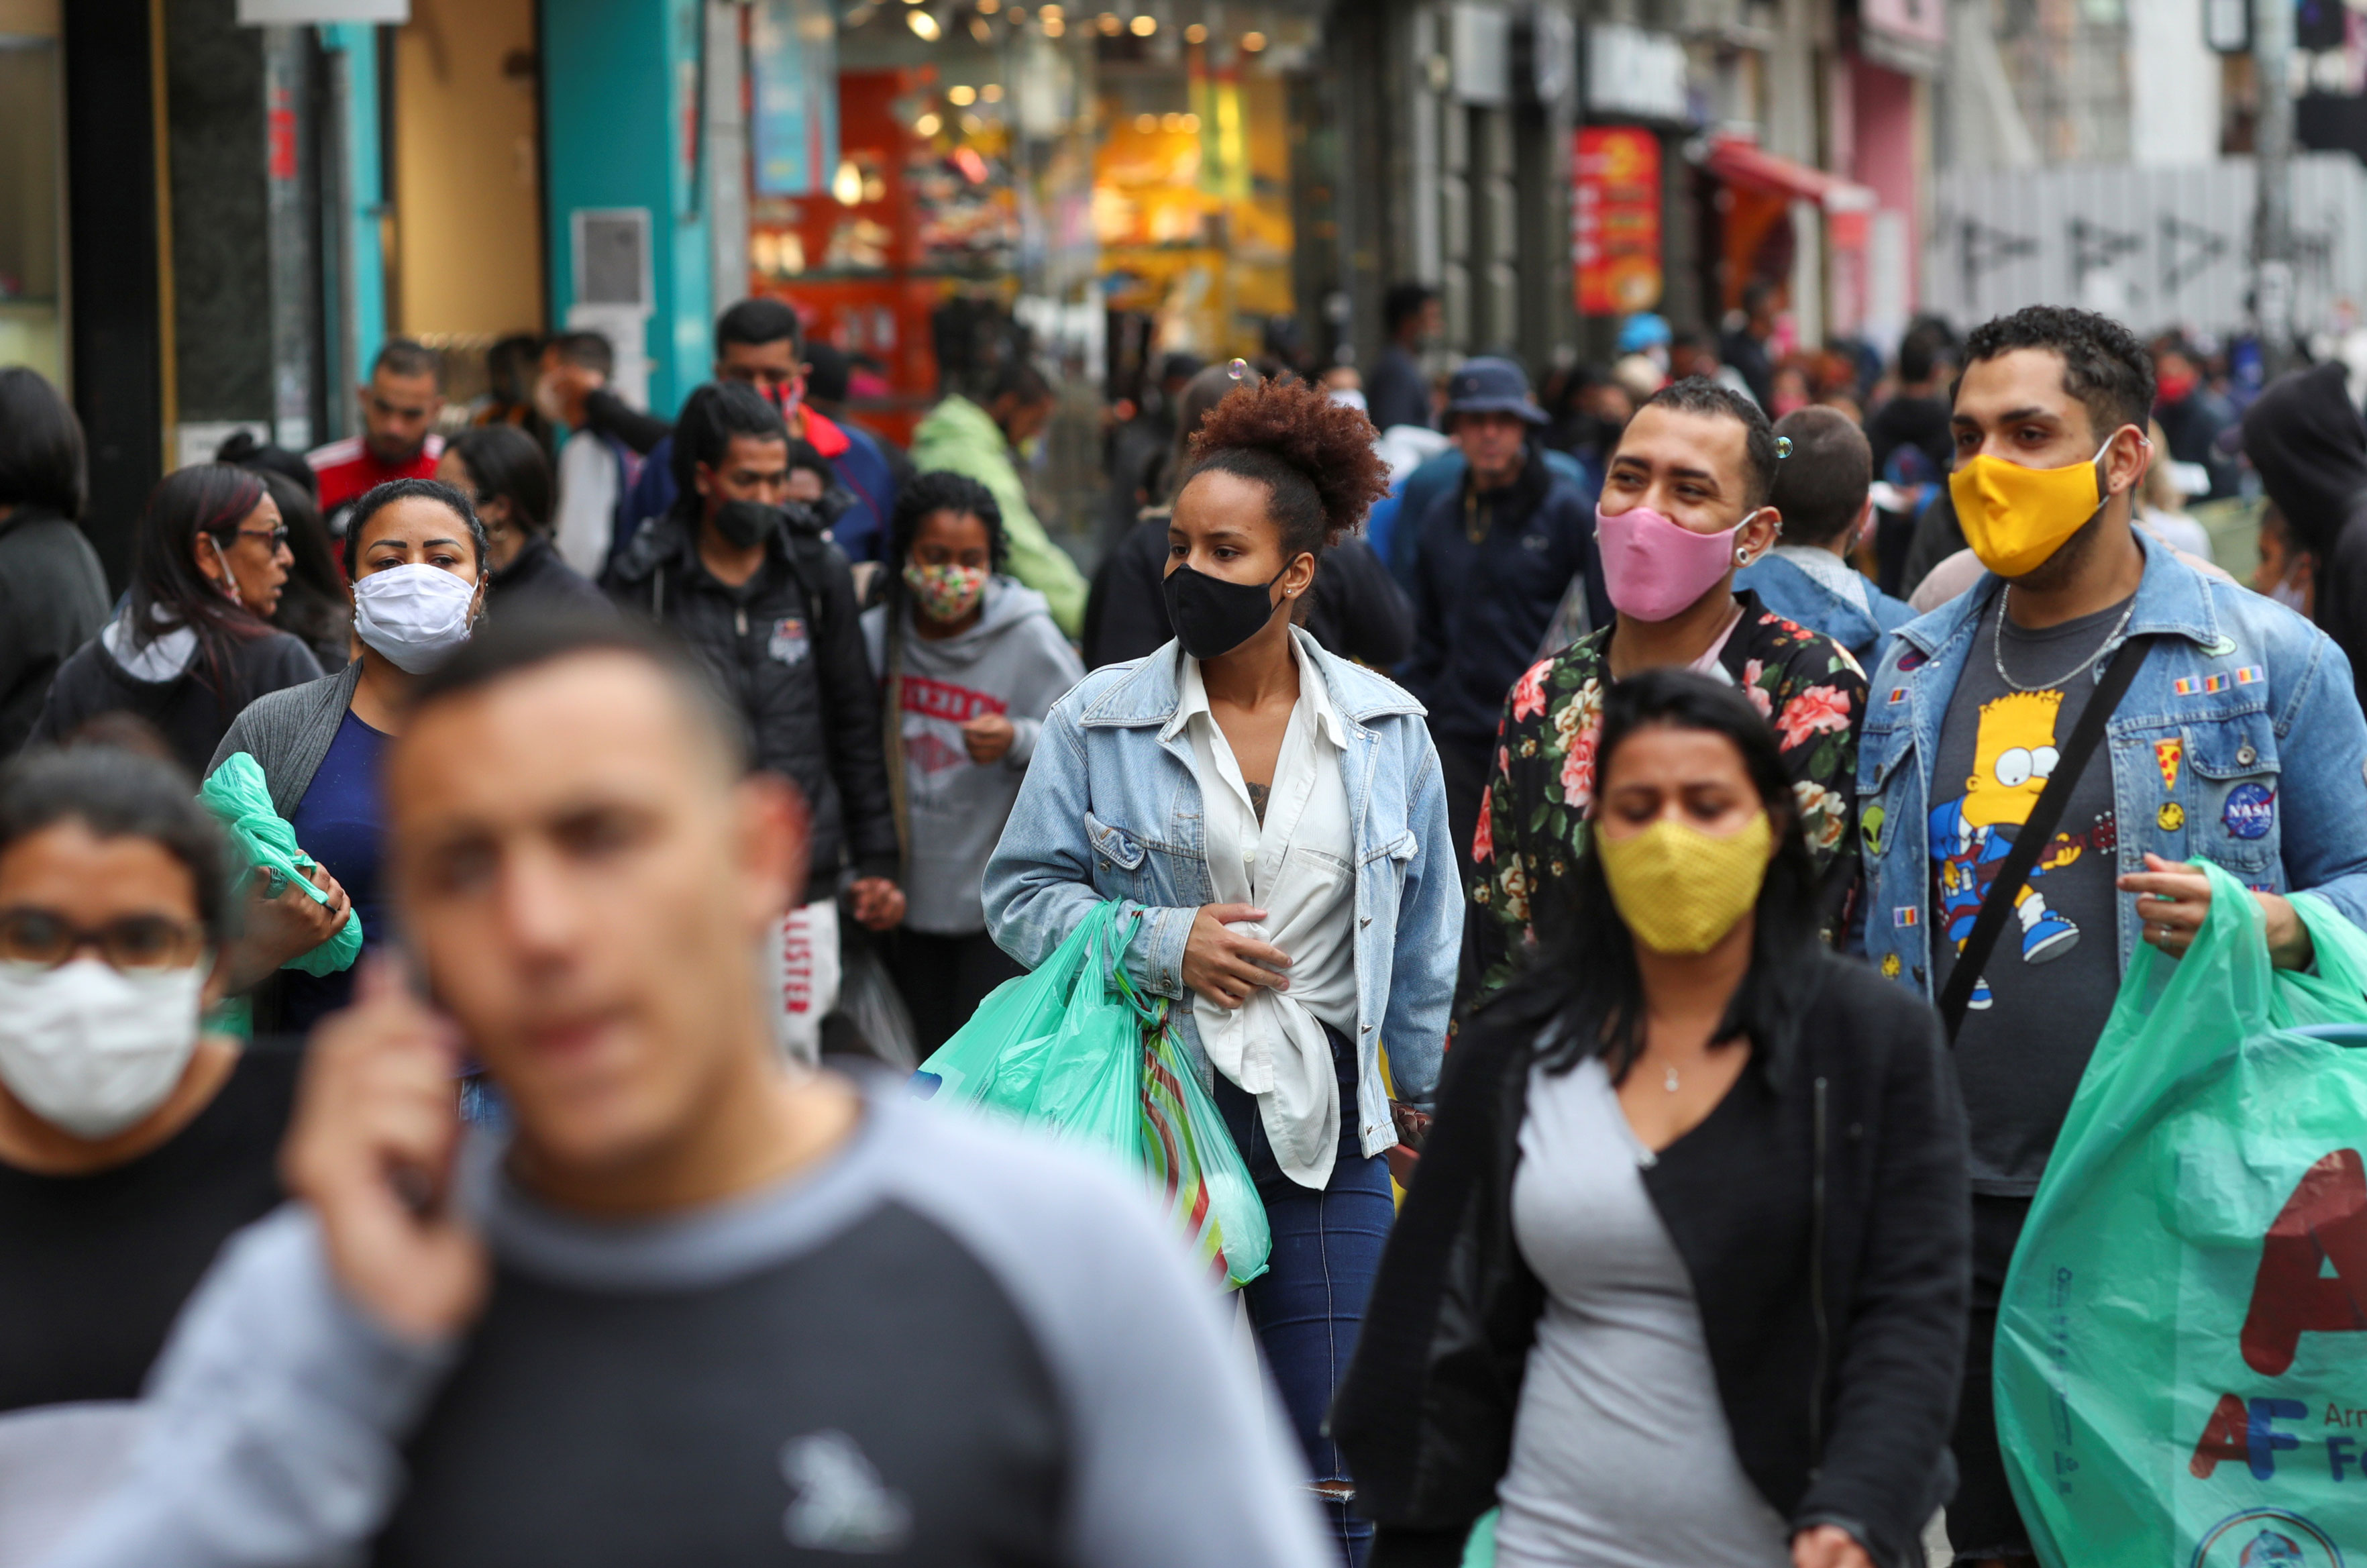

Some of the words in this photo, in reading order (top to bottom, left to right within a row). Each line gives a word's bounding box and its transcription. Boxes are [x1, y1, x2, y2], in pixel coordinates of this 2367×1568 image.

[2229, 804, 2271, 818] NASA
[2189, 1392, 2309, 1481] AF
[2326, 1436, 2367, 1482] F
